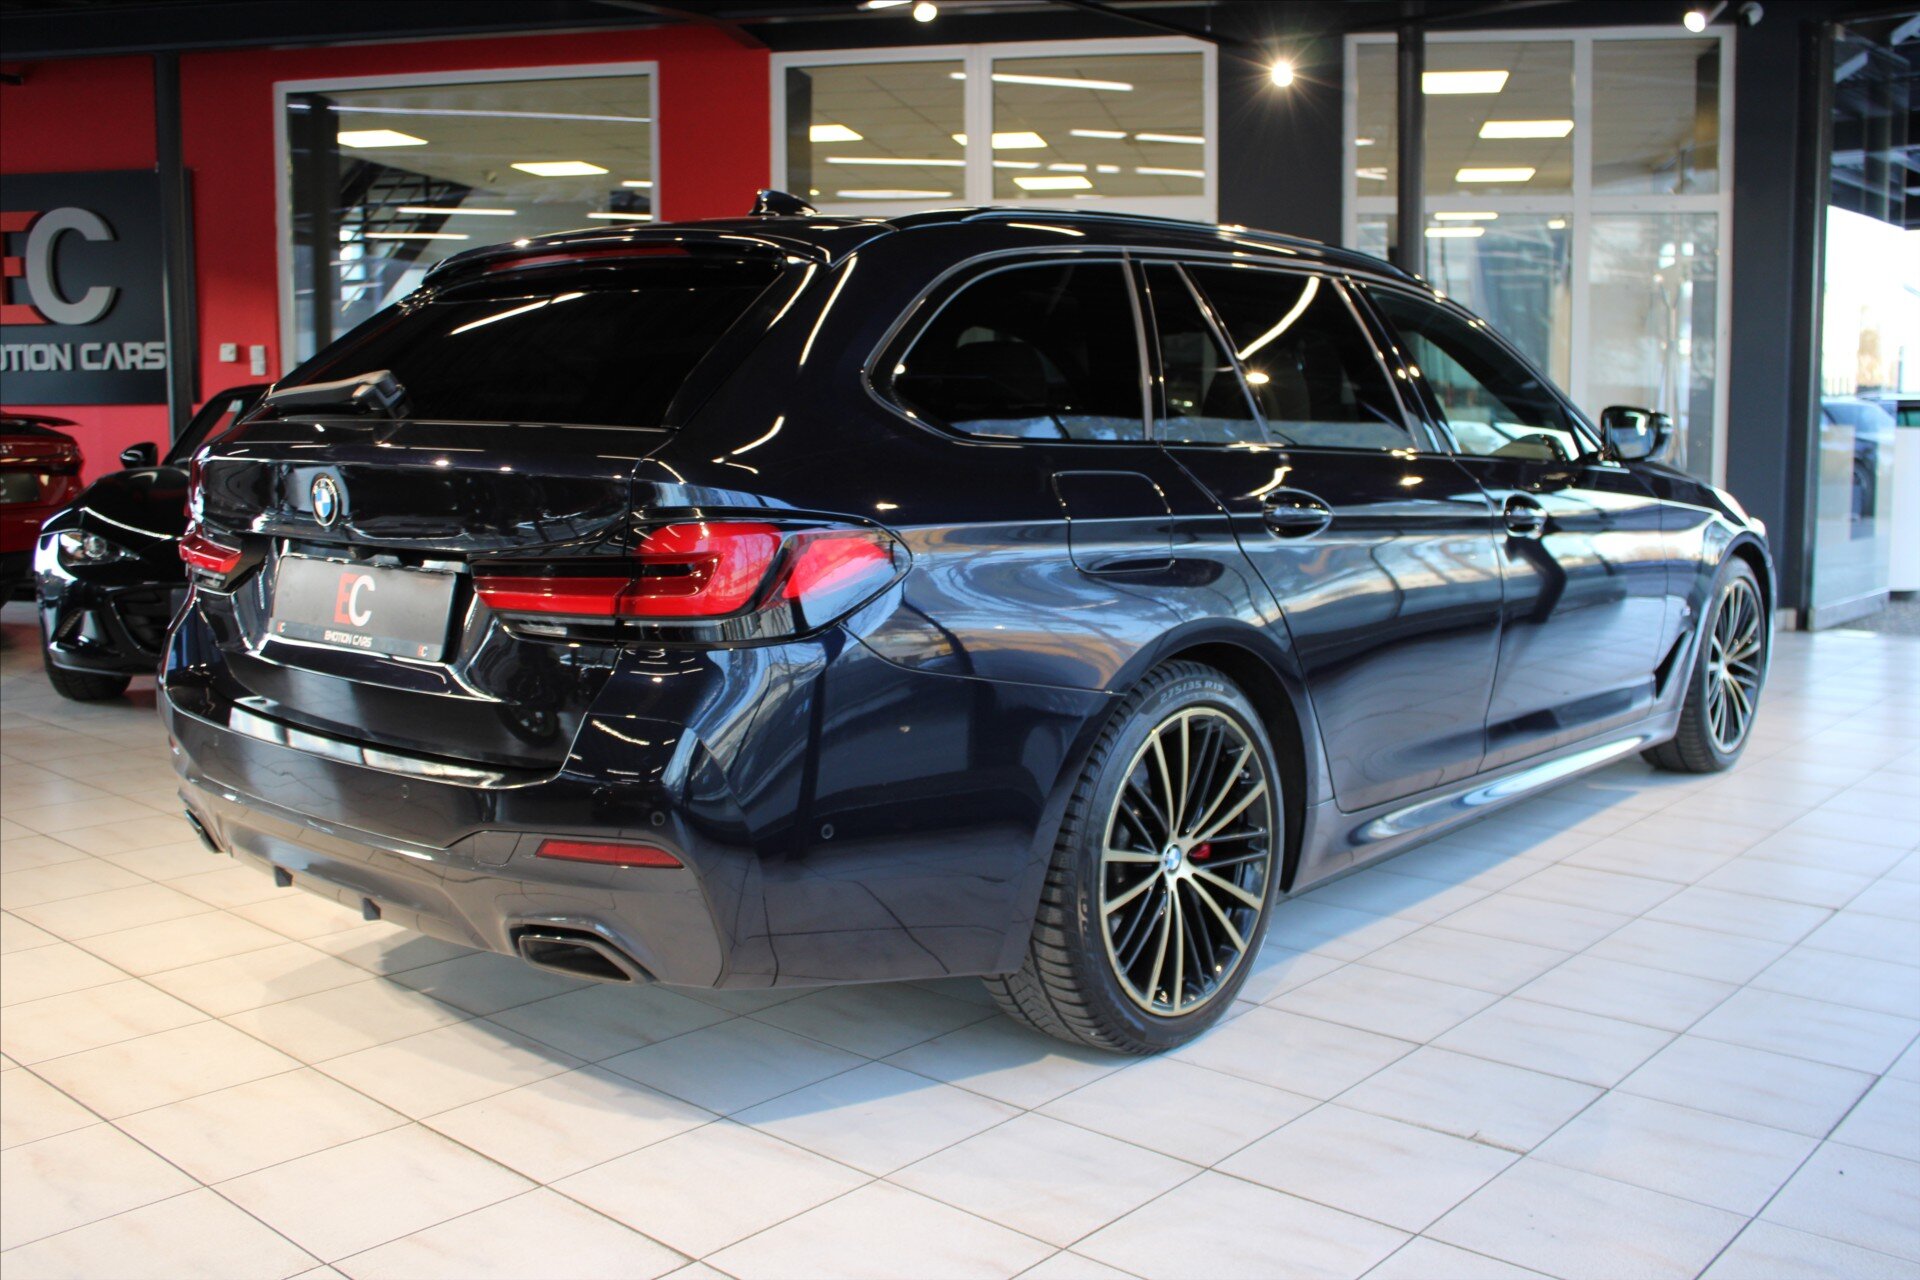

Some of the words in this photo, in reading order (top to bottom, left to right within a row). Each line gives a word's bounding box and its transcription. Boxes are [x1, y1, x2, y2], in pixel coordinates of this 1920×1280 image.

[80, 342, 166, 370] CARS
[334, 573, 375, 627] EC
[352, 635, 373, 648] CARS
[1160, 681, 1202, 702] 275/35
